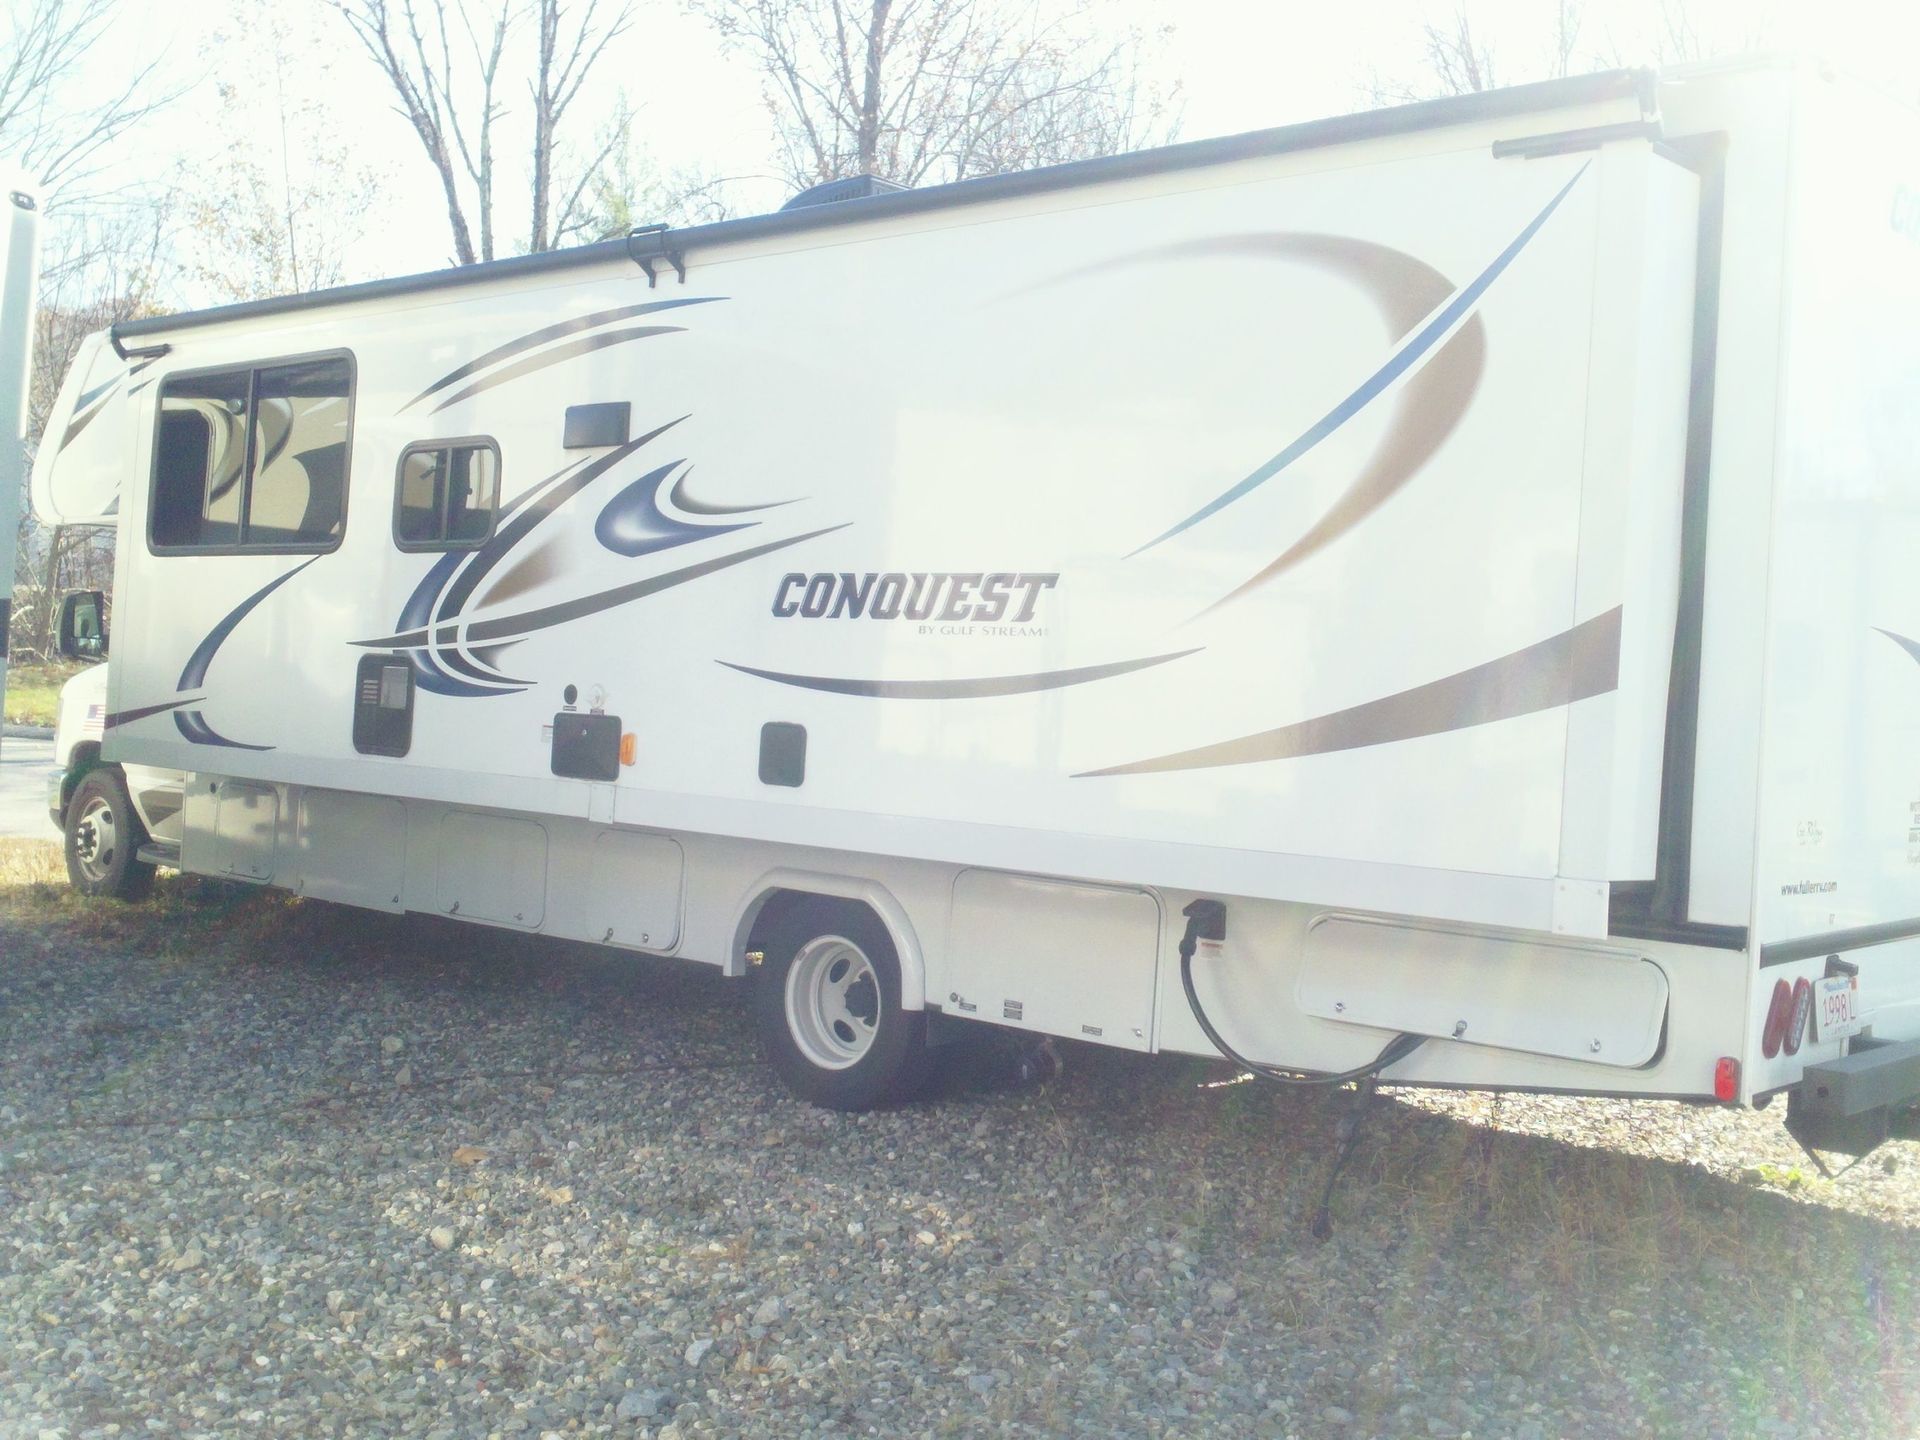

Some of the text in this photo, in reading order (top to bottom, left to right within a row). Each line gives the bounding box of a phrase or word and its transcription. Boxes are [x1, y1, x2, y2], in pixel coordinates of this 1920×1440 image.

[771, 572, 1060, 622] CONQUEST
[918, 625, 1042, 637] BY GULF STREAM
